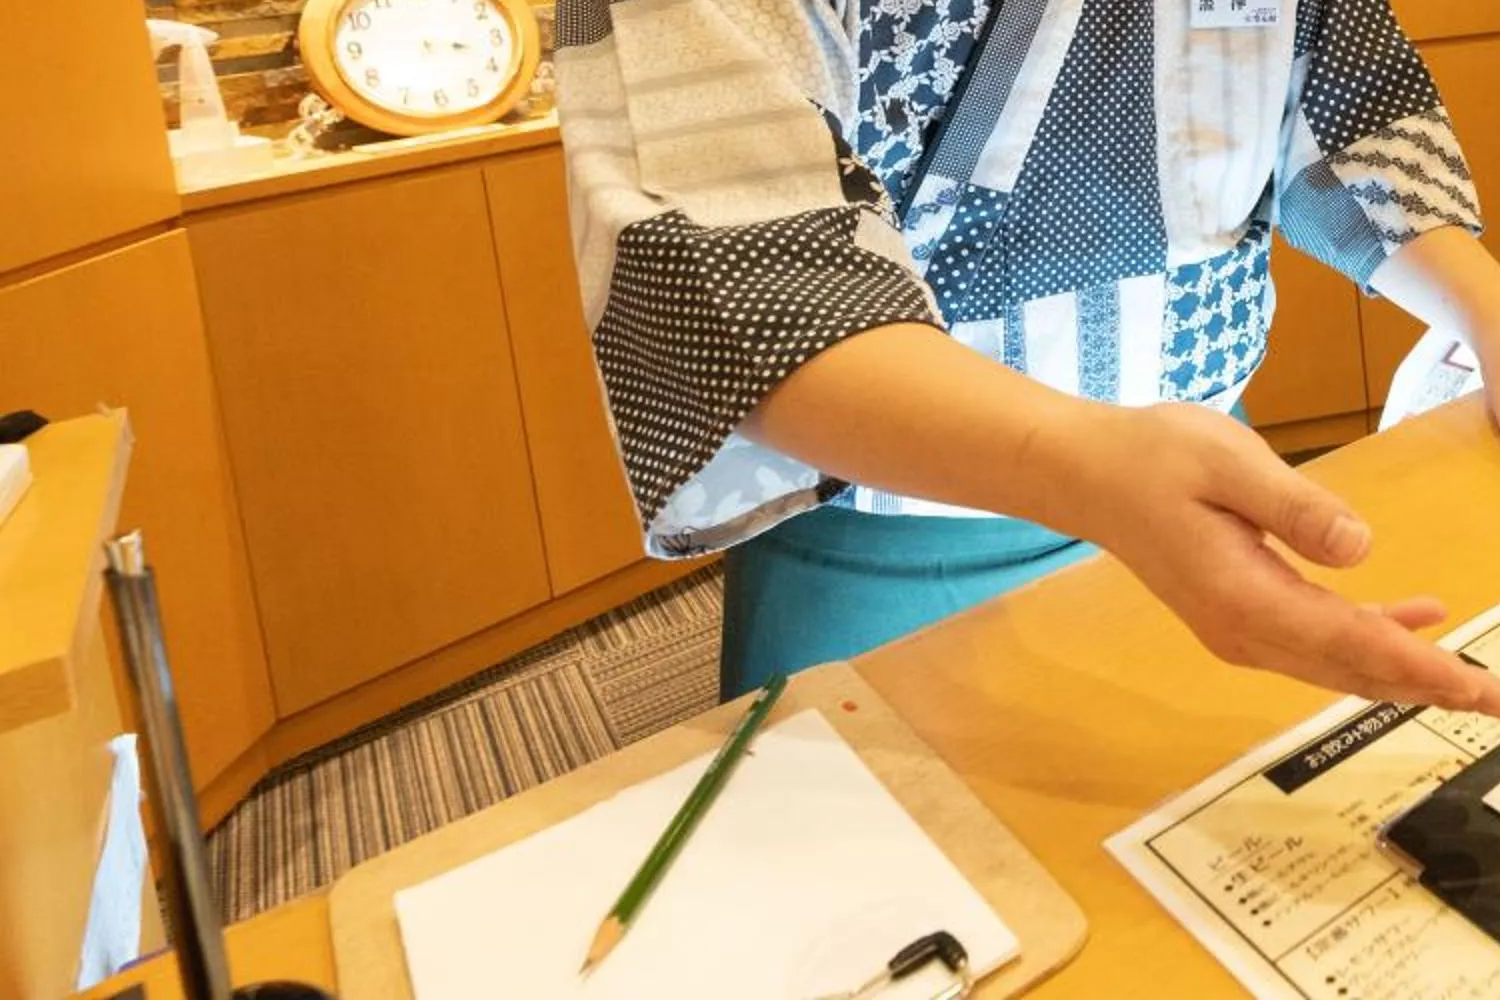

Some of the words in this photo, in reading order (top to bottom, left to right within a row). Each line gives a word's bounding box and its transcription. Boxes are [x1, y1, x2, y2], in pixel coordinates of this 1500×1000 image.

[474, 1, 488, 20] 2
[348, 11, 371, 31] 10
[490, 29, 503, 47] 3
[346, 41, 362, 60] 9
[486, 57, 498, 72] 4
[364, 69, 380, 88] 8
[466, 78, 479, 98] 5
[400, 87, 411, 104] 7
[433, 88, 449, 106] 6
